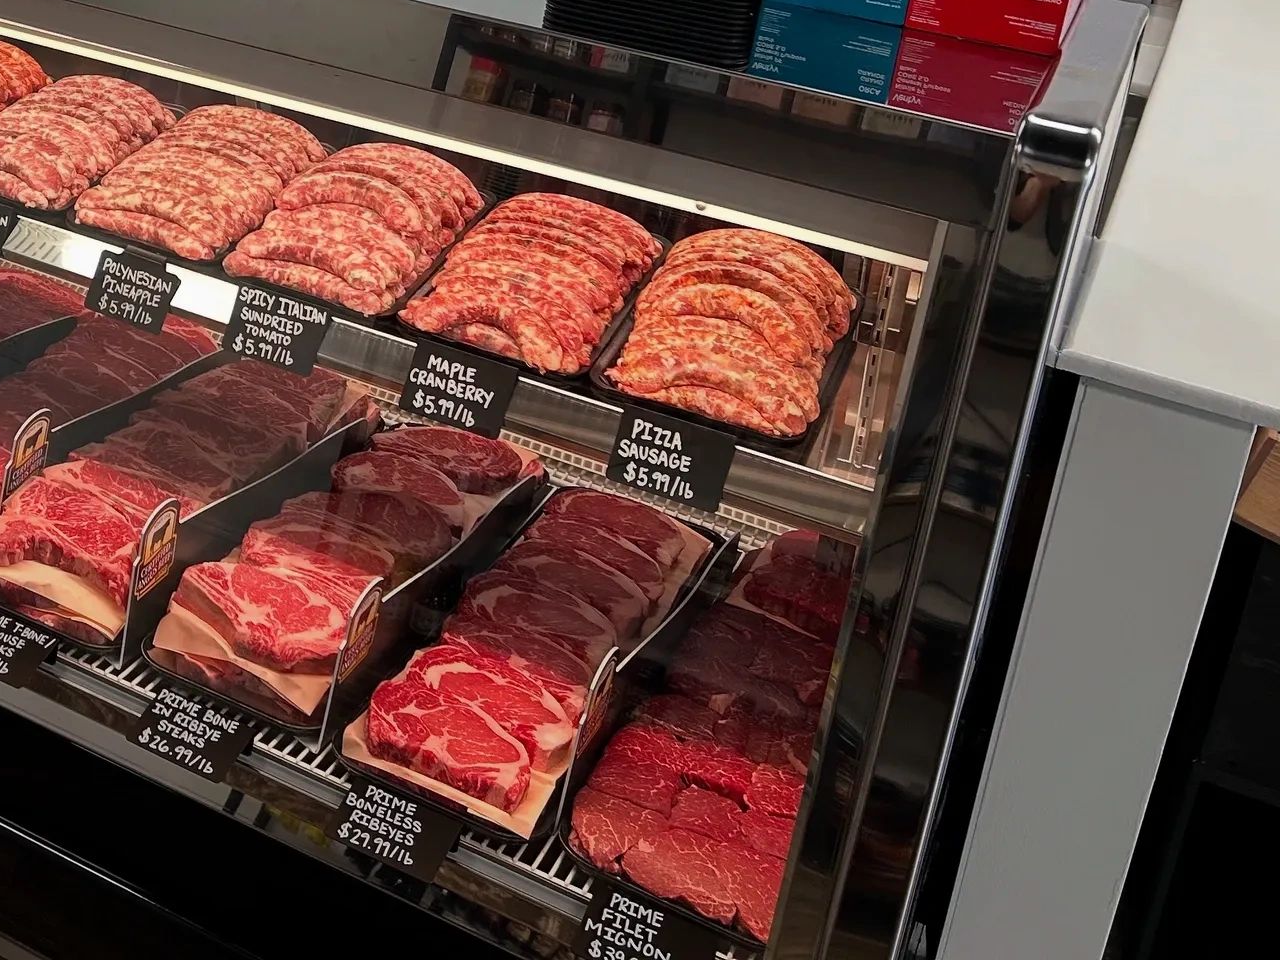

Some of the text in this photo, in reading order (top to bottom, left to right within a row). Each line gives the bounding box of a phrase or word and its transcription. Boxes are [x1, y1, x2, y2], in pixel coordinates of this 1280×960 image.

[102, 257, 173, 295] POLYNESIAN
[102, 277, 162, 308] PINEAPPLE
[98, 294, 153, 326] $5.99/lb
[239, 286, 328, 326] SPICY ITALIAN
[240, 307, 304, 336] SUNDRIED
[231, 334, 295, 367] $5.99/lb
[244, 323, 293, 347] TOMATO
[427, 354, 477, 384] MAPLE
[410, 368, 495, 410] CRANBERRY
[412, 389, 476, 429] $5.99/lb
[631, 418, 683, 451] PIZZA
[618, 440, 692, 473] SAUSAGE
[623, 461, 694, 500] $5.99/lb
[152, 702, 222, 743] IN RIBEYE
[157, 688, 240, 735] PRIME BONE
[138, 727, 215, 776] $26.99/lb
[157, 719, 206, 750] STEAKS
[345, 792, 423, 834] BONELESS
[365, 785, 418, 817] PRIME
[337, 823, 415, 867] $29.99/lb
[349, 810, 415, 847] RIBEYES
[602, 908, 658, 943] FILET
[609, 892, 665, 928] PRIME
[584, 918, 672, 960] MIGNON
